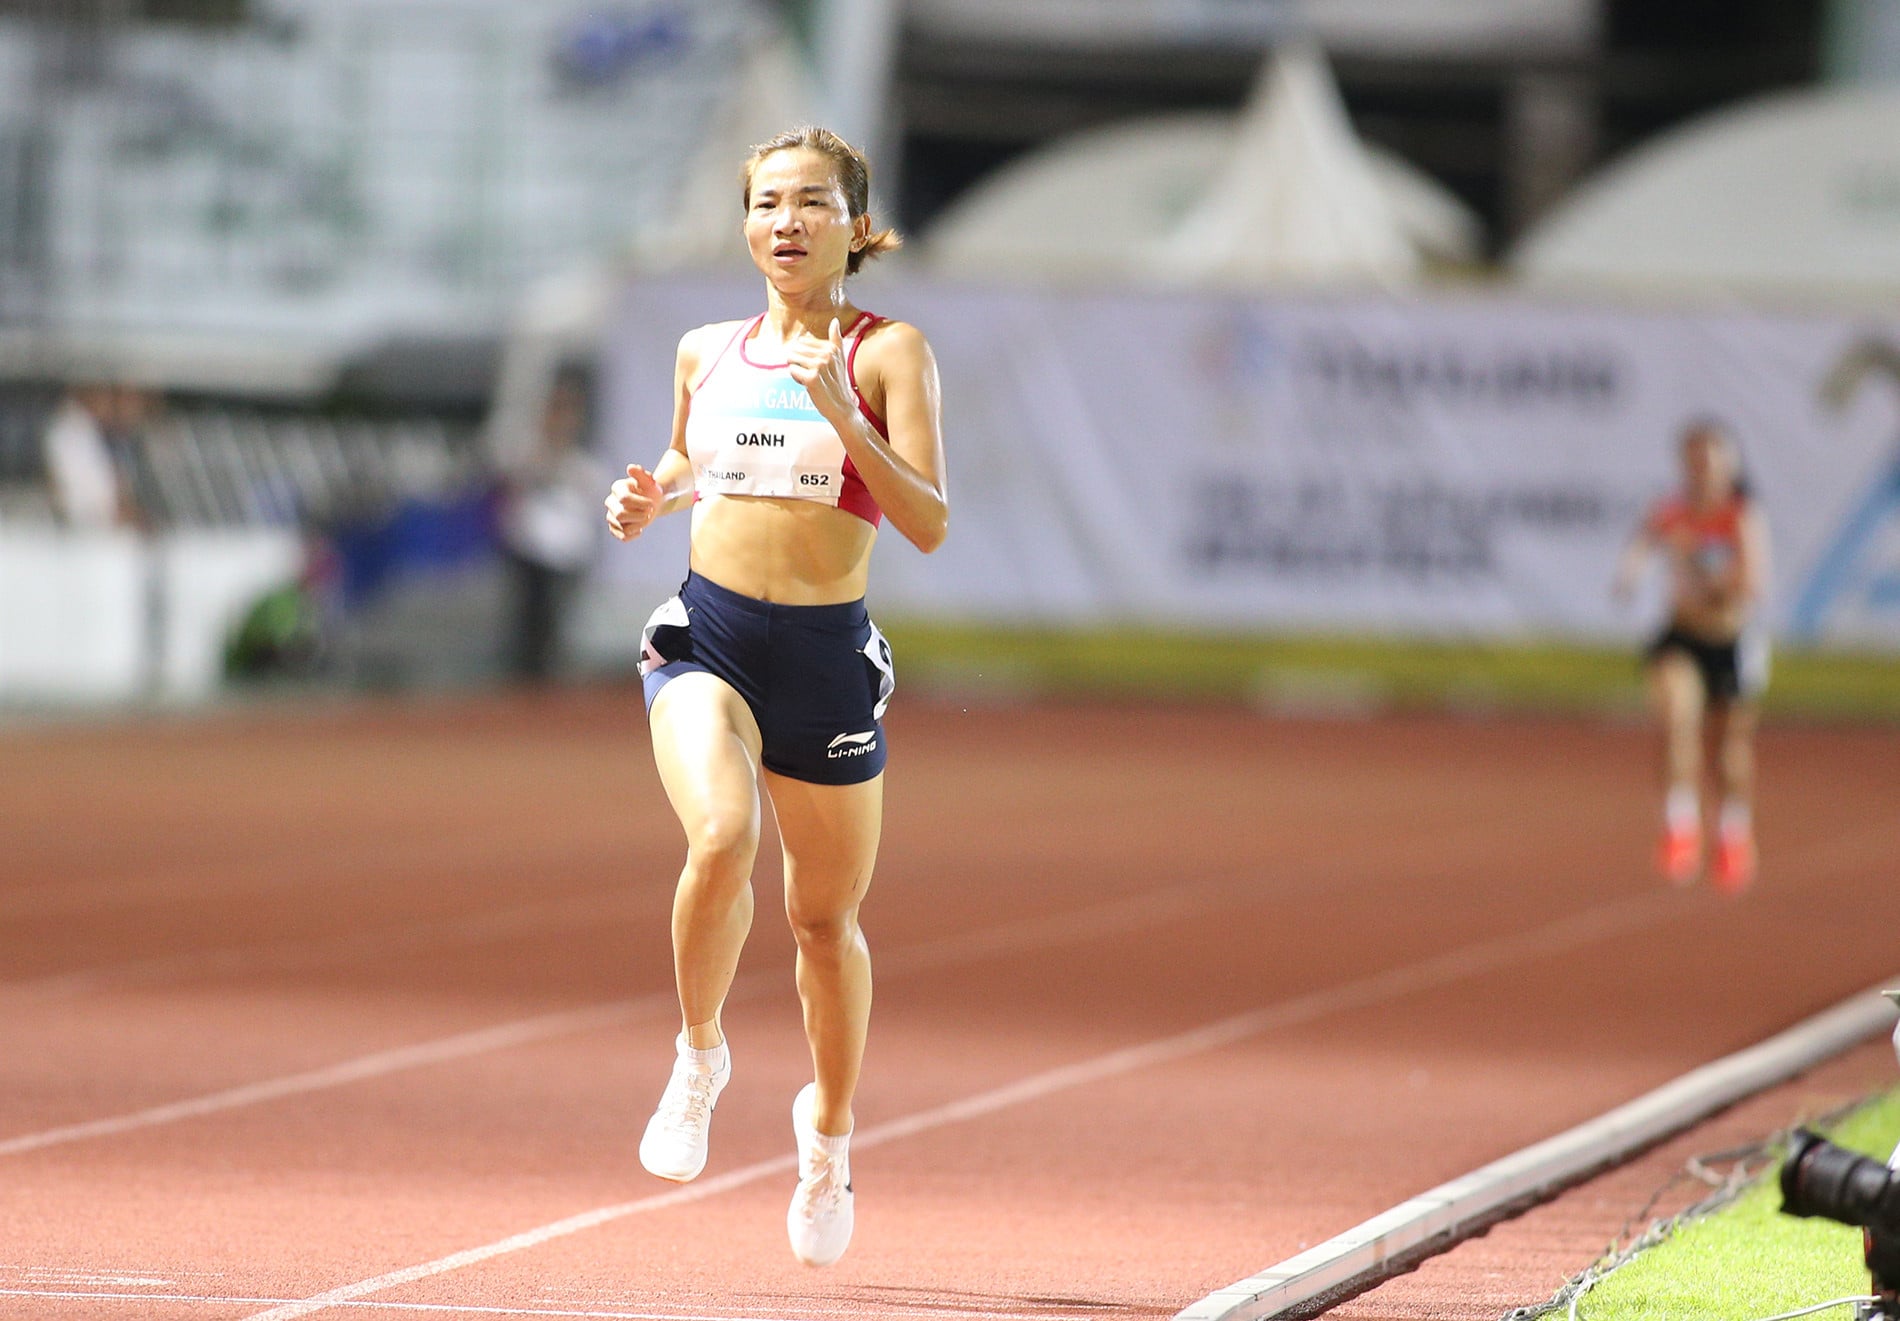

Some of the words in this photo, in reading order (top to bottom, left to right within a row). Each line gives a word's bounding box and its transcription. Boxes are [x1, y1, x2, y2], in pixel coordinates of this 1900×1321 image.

[735, 432, 785, 448] OANH
[707, 470, 746, 481] THAILAND
[800, 474, 830, 486] 652
[827, 740, 877, 759] LI-NING
